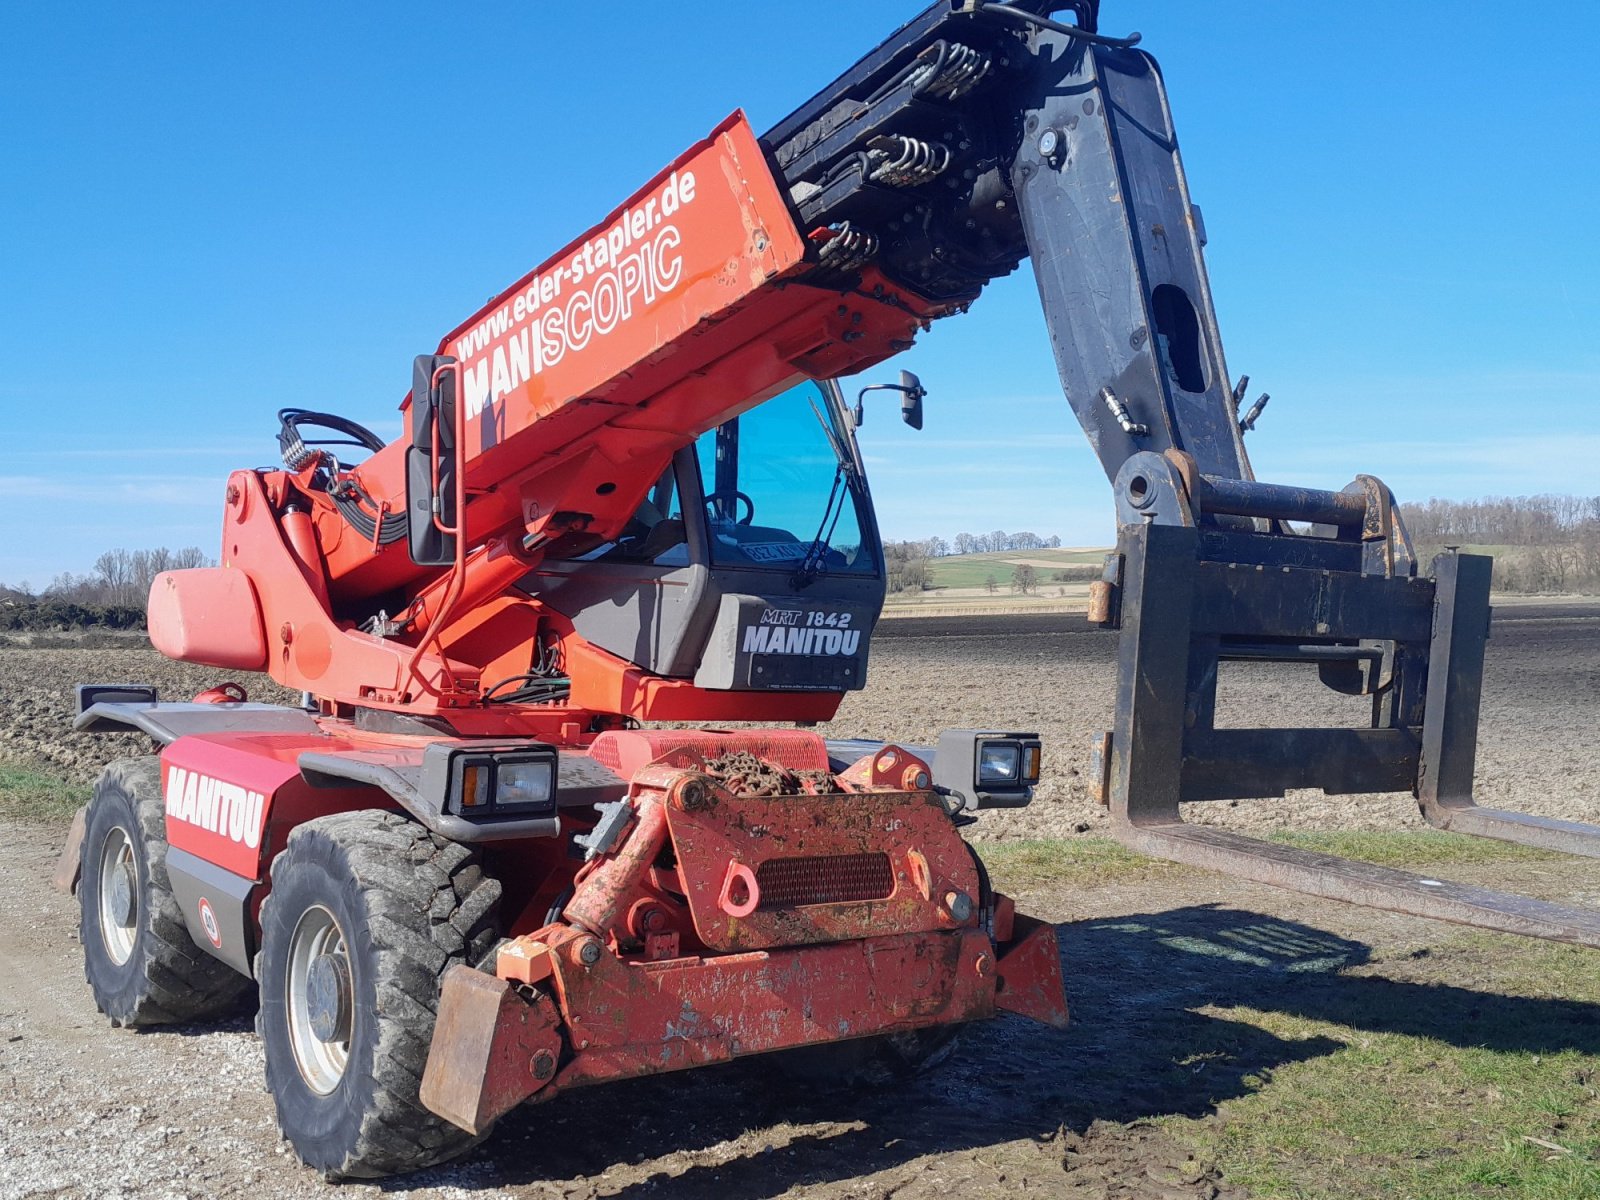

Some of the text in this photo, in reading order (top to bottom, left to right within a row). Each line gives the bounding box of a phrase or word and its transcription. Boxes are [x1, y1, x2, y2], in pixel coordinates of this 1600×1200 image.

[456, 171, 696, 363] www.eder-stapler.de
[463, 225, 682, 421] MANISCOPIC
[742, 625, 860, 656] MANITOU
[760, 608, 852, 627] MRT 1842
[166, 766, 264, 849] MANITOU
